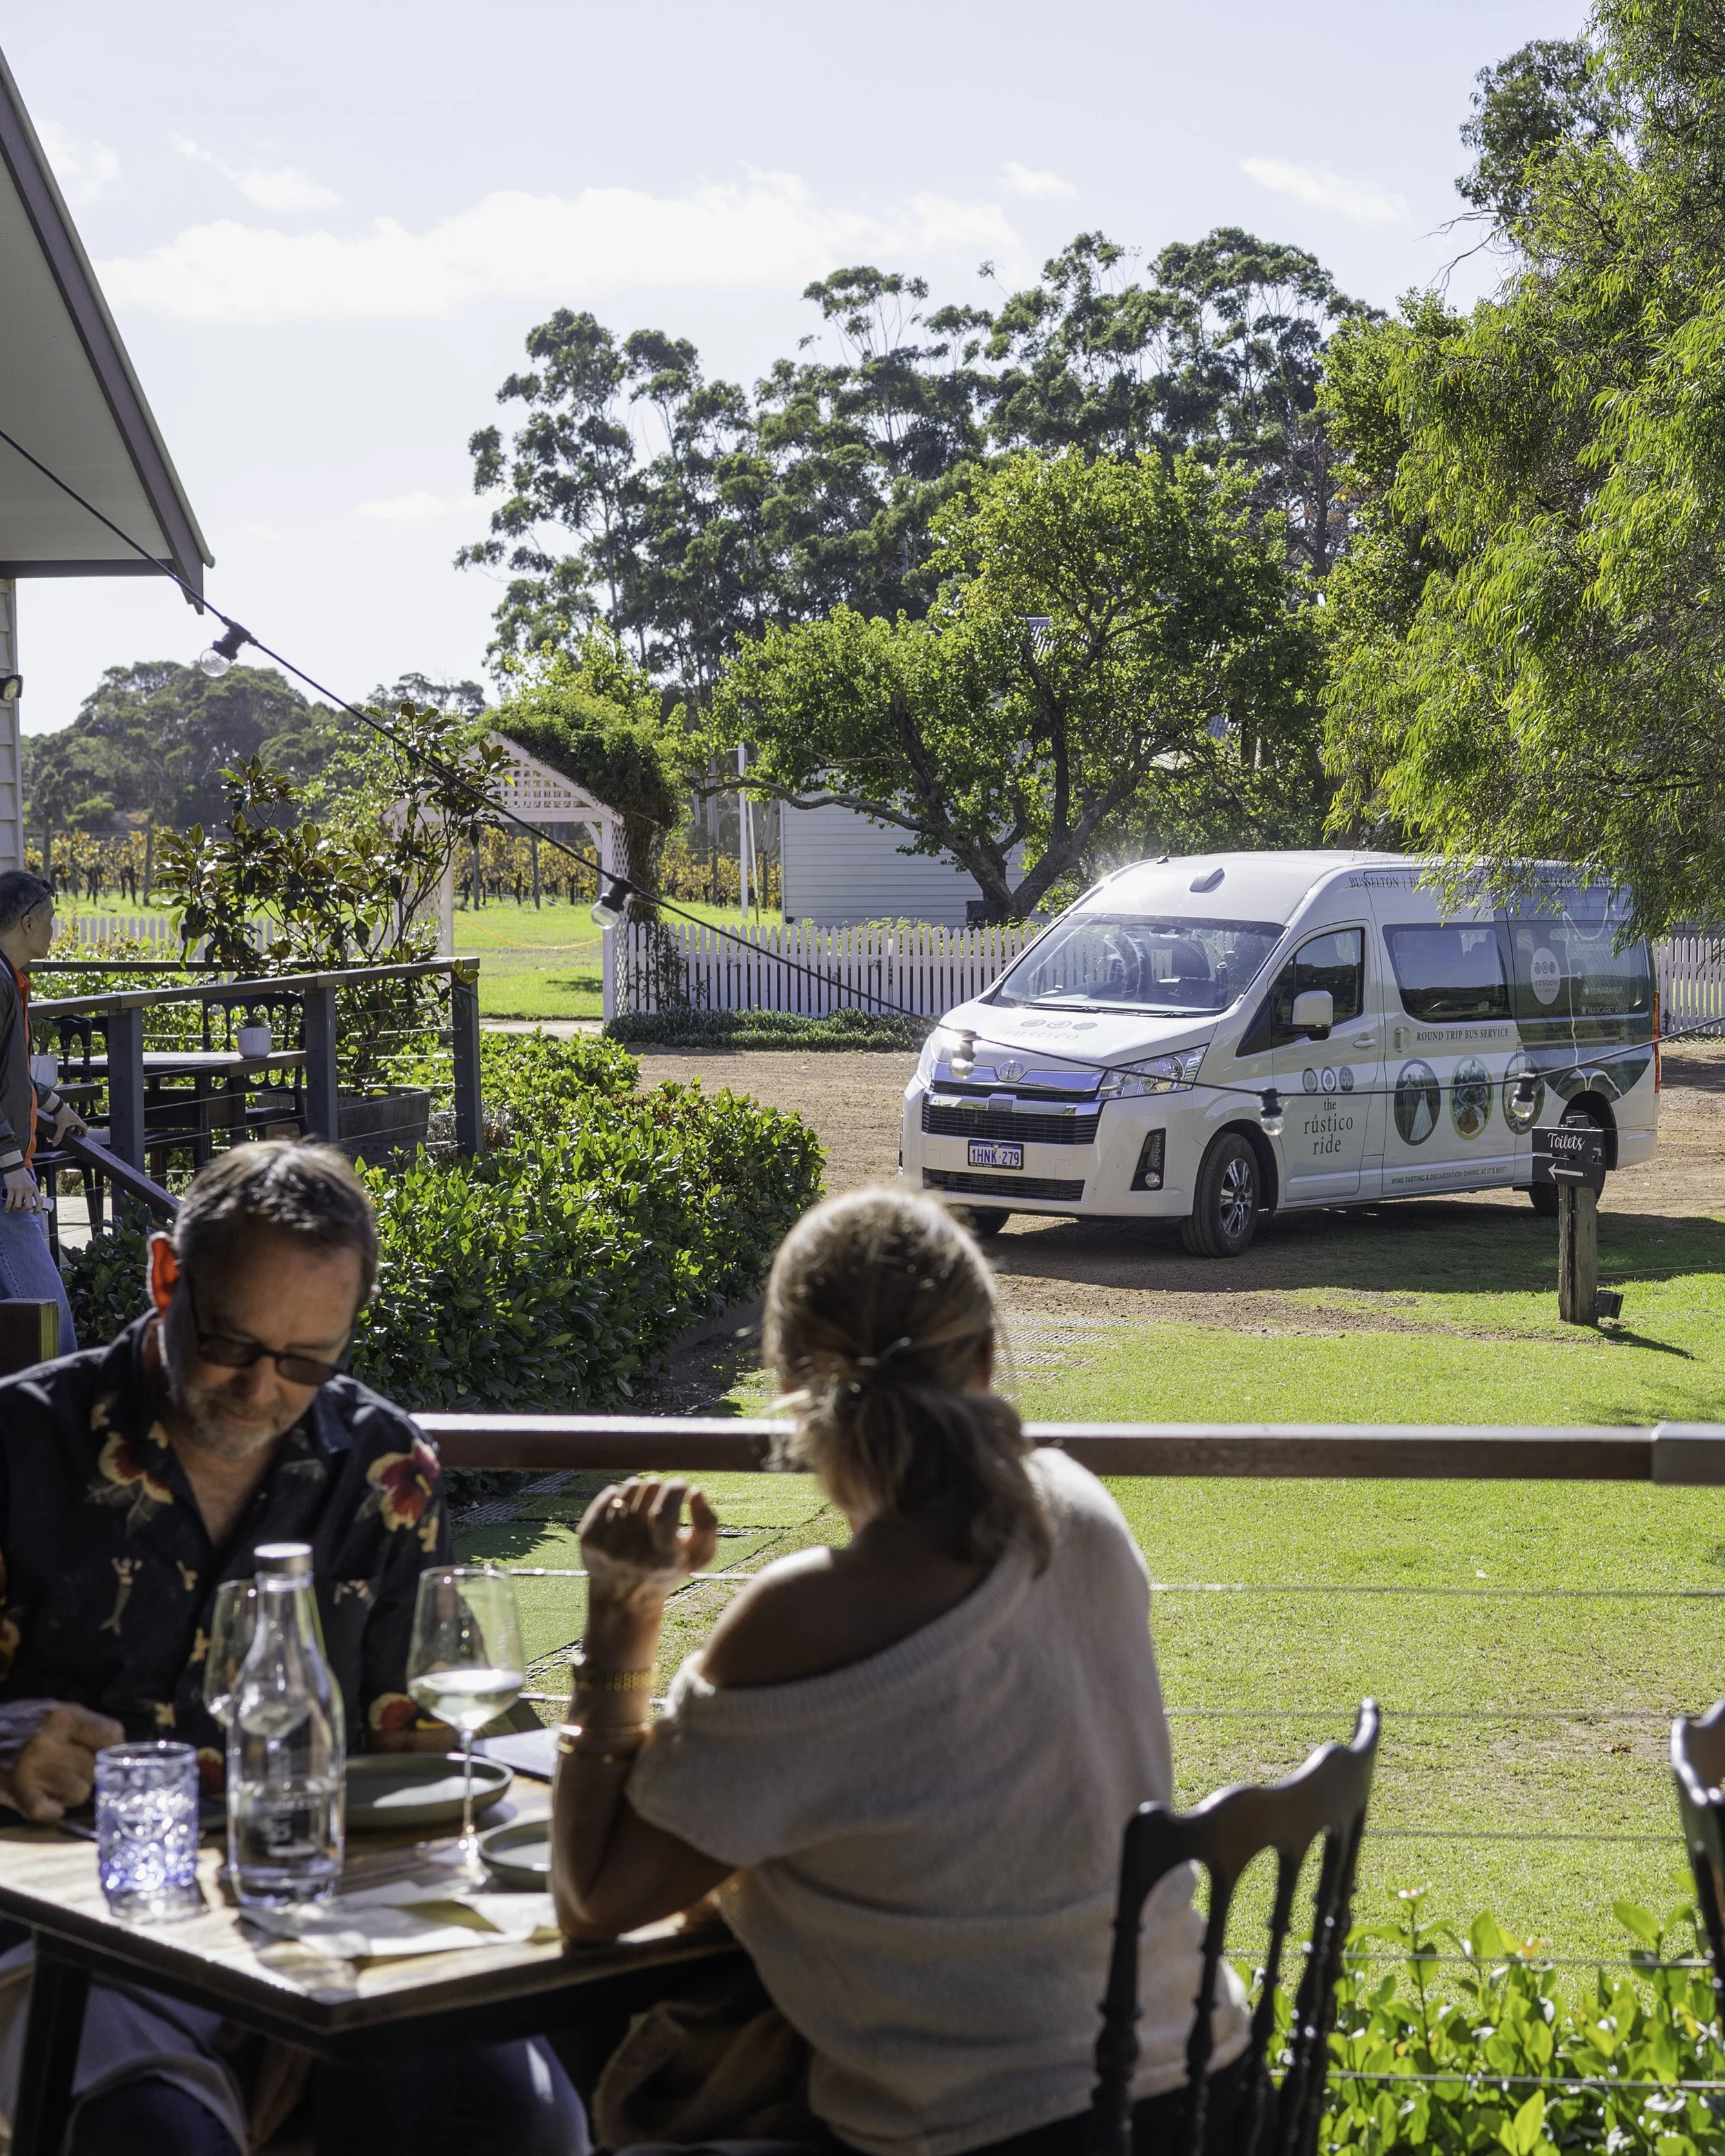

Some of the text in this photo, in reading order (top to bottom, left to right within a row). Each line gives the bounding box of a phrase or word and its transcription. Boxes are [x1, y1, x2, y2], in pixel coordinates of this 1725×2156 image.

[1349, 877, 1399, 888] BUSSELTON
[1615, 1005, 1629, 1013] RIVER
[1417, 1028, 1509, 1041] ROUND TRIP BUS SERVICE
[1323, 1098, 1337, 1111] the
[1303, 1114, 1353, 1134] rústico
[1312, 1134, 1341, 1155] ride
[1547, 1132, 1586, 1151] Toilets
[1430, 1171, 1463, 1180] DEGUSTATION
